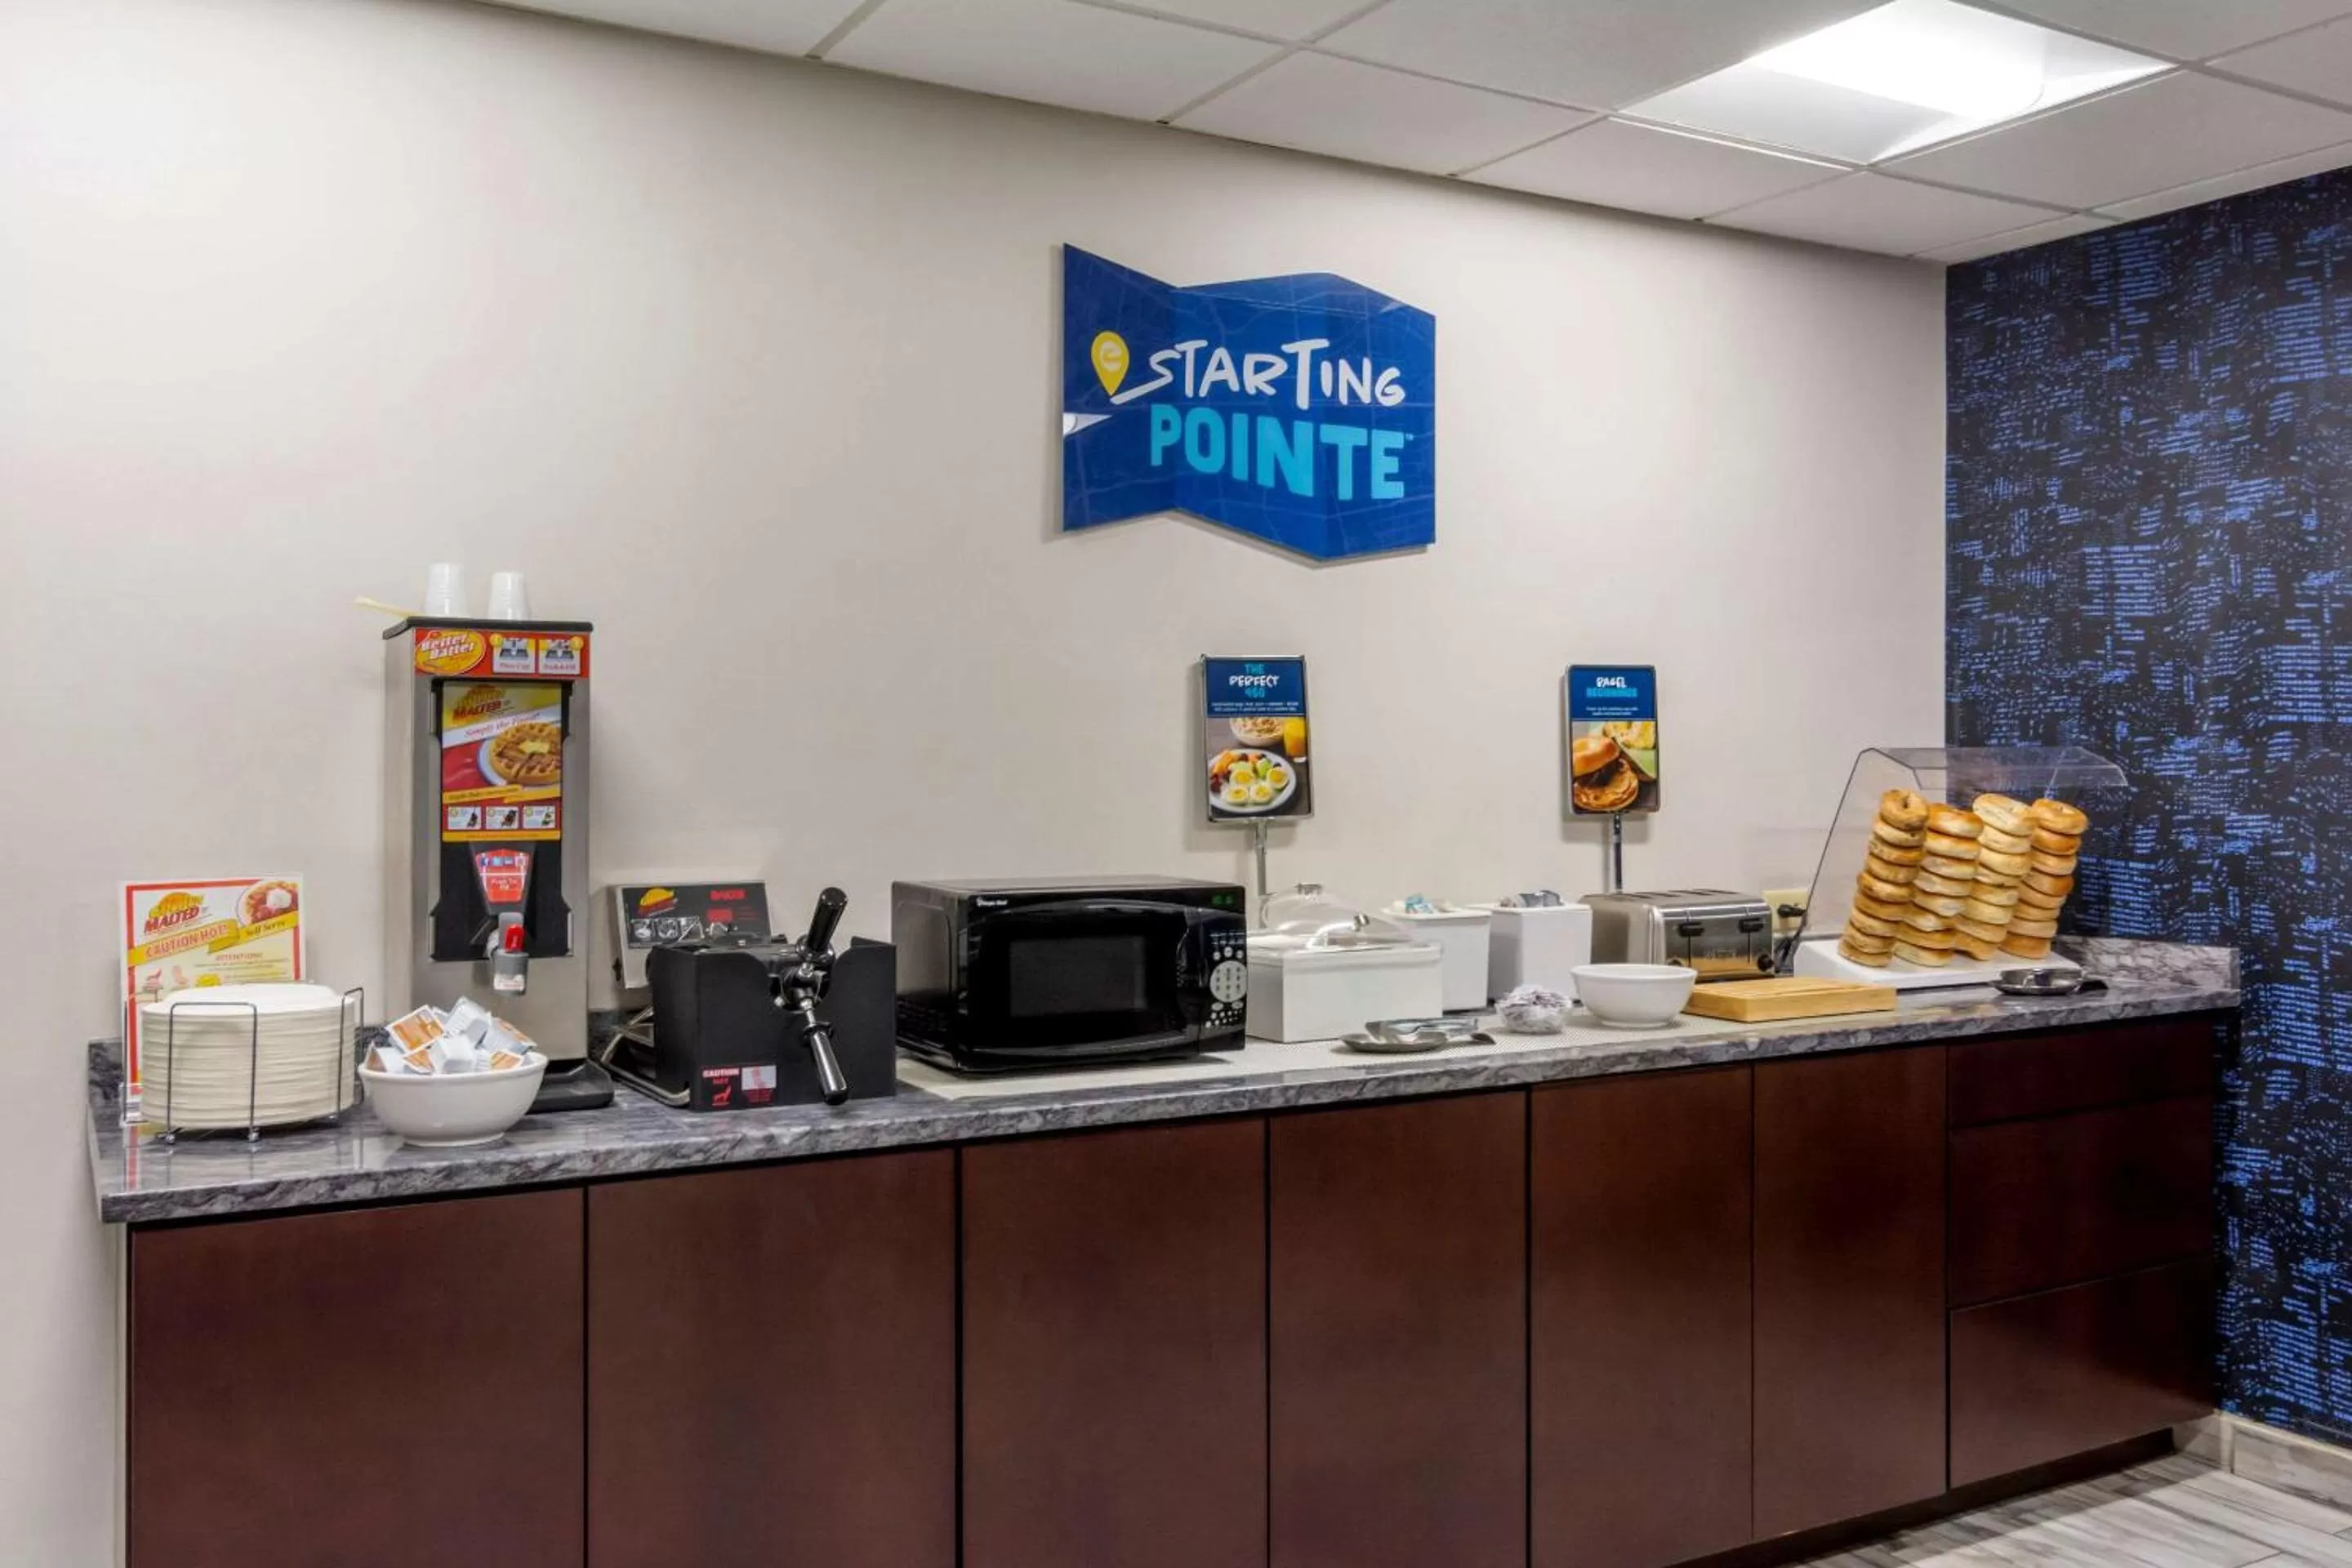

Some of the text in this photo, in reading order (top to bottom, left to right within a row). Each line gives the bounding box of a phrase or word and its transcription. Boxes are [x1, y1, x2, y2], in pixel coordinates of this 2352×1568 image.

[1111, 338, 1406, 410] STARTING
[1150, 403, 1405, 501] POINTE
[1228, 675, 1281, 688] PERFECT
[144, 905, 200, 935] MALTED
[145, 933, 200, 958] CAUTION
